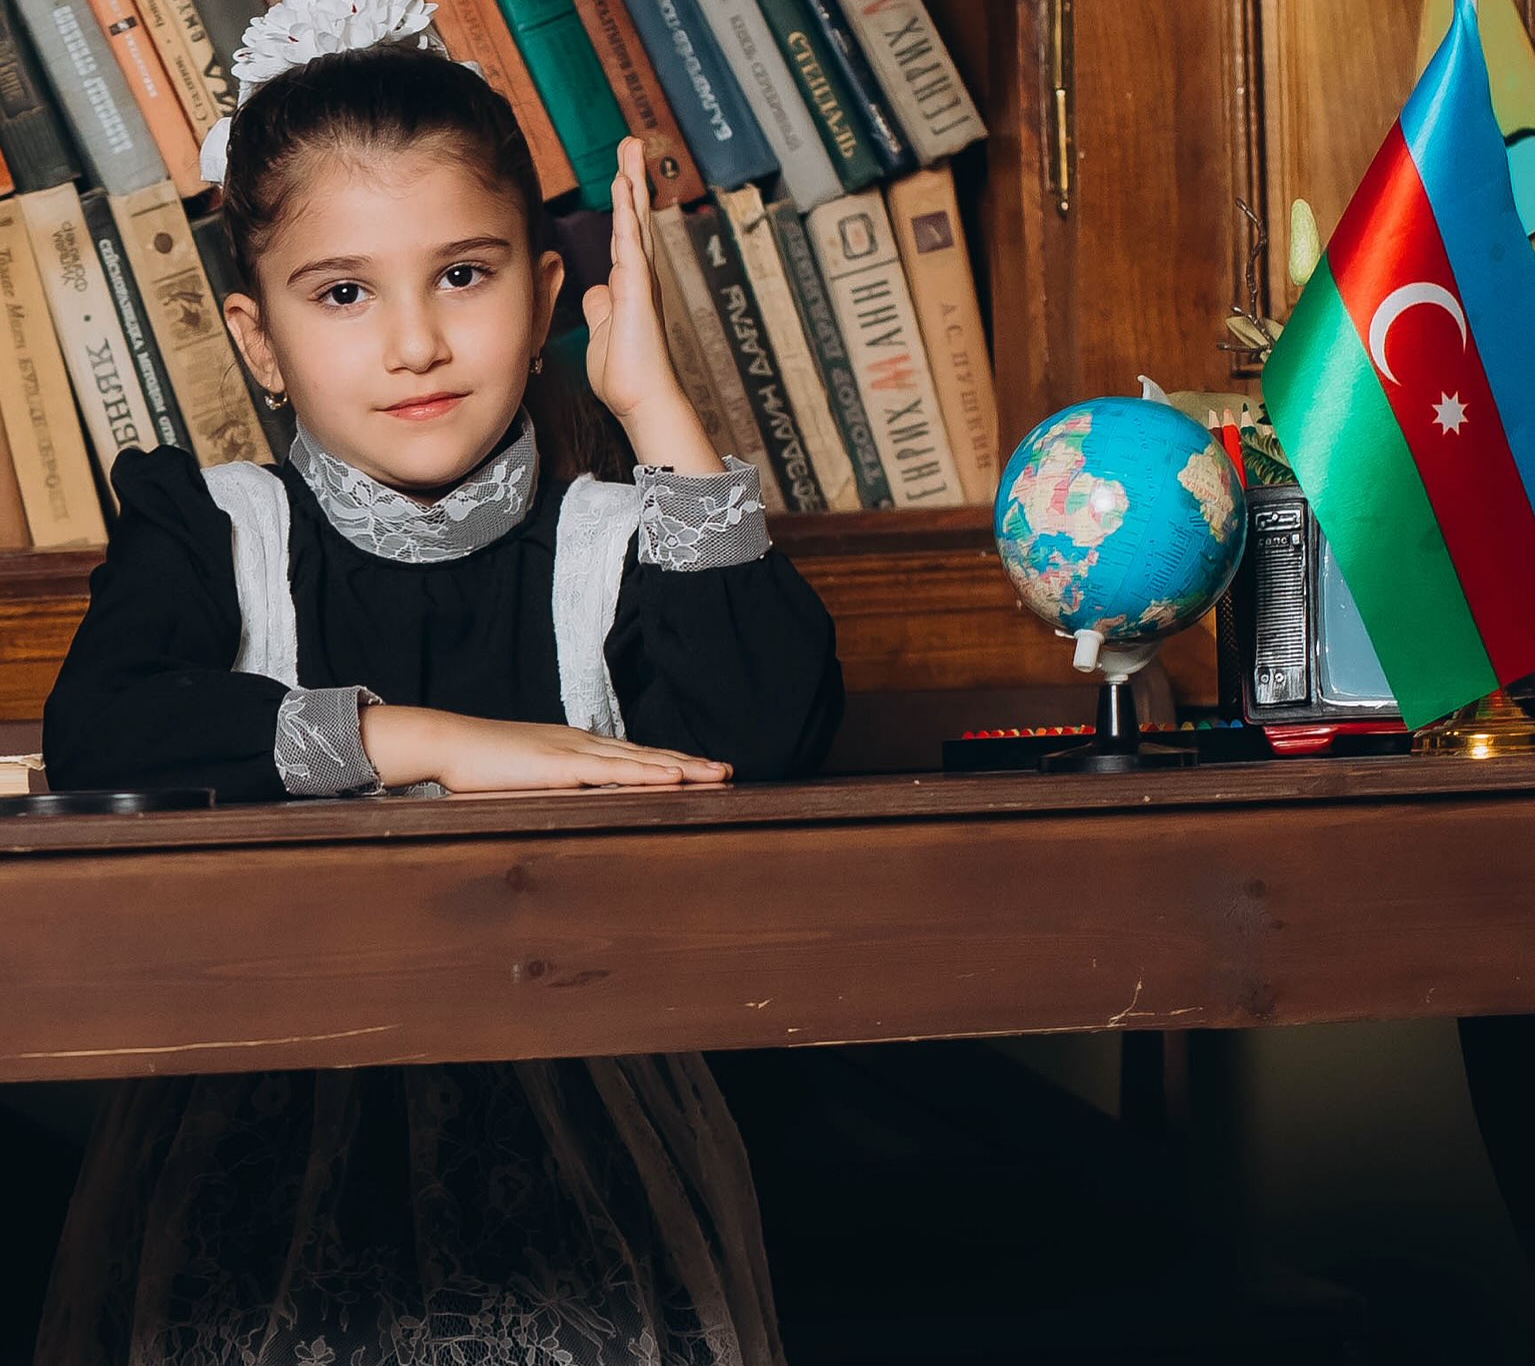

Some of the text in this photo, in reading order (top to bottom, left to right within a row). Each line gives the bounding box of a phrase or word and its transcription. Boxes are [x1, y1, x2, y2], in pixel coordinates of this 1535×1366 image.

[785, 26, 860, 160] СТЕНДАЛЬ
[881, 14, 971, 138] ГЕНРИХ
[706, 234, 727, 267] 1
[84, 337, 140, 448] БНЯК
[97, 236, 180, 451] СЕЙСМОРАЗВЕДКА МЕТОДОМ ОТРА
[836, 276, 952, 503] ЕНРИХ МАНН
